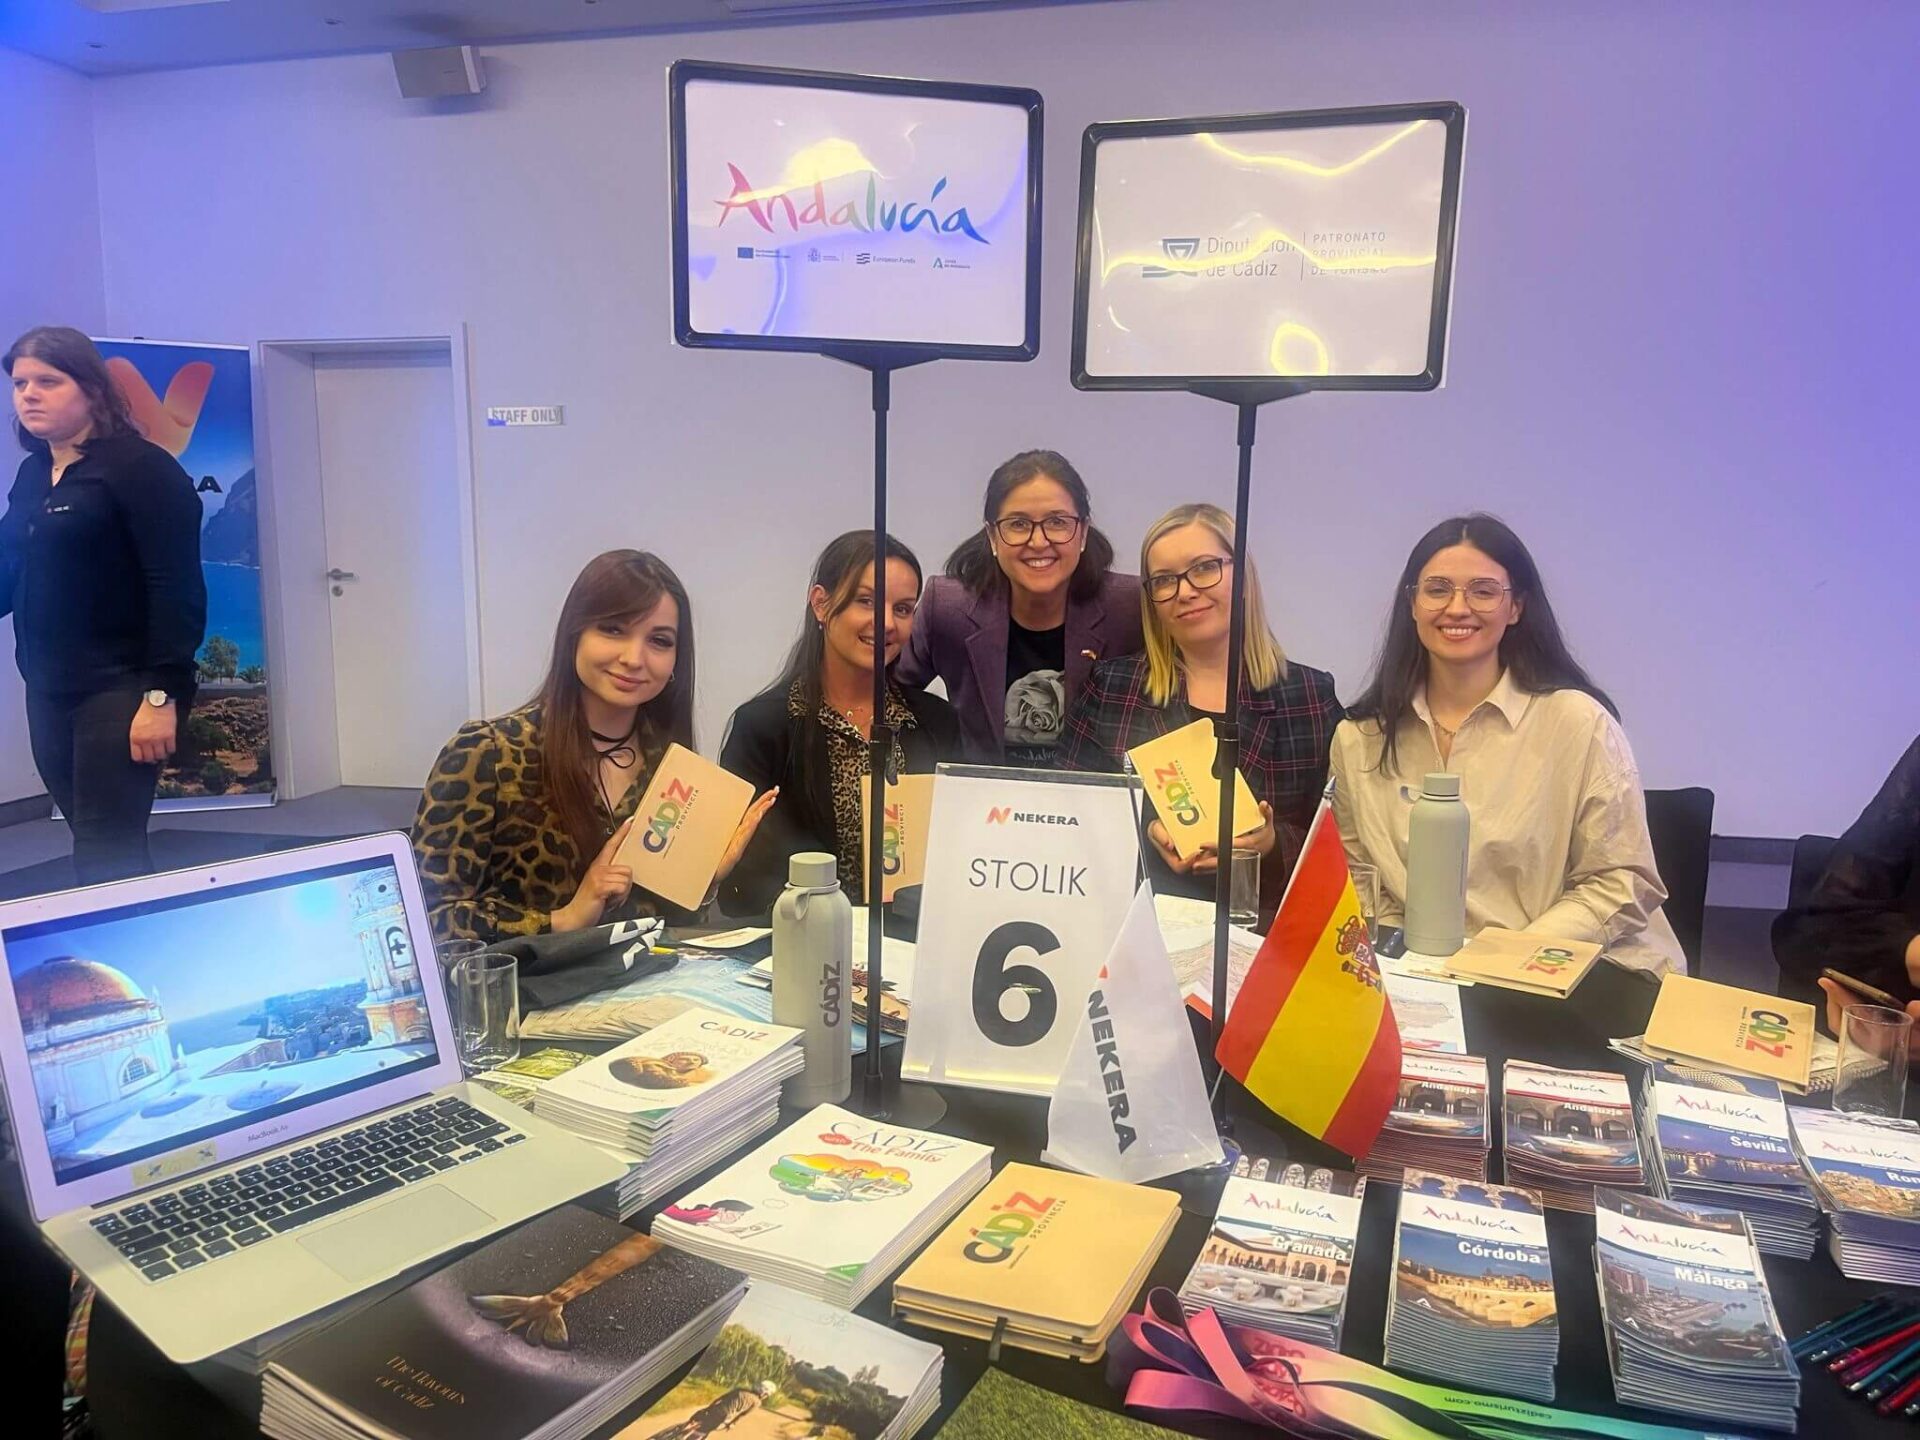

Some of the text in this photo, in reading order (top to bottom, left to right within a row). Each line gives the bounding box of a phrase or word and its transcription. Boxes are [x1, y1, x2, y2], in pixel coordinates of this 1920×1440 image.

[713, 162, 991, 245] Andalucía
[1313, 231, 1386, 243] PATRONATO
[492, 409, 561, 423] STAFF ONLY
[1013, 812, 1080, 826] NEKERA
[968, 858, 1087, 897] STOLIK
[972, 920, 1061, 1047] 6
[1088, 989, 1137, 1155] NEKERA
[1675, 1094, 1768, 1123] Andalucía
[851, 1142, 943, 1163] The Family
[1730, 1135, 1787, 1154] Sevilla
[1822, 1140, 1917, 1162] Andalucía
[1029, 1200, 1066, 1239] PROVINCIA
[1244, 1192, 1341, 1223] Andalucía
[1422, 1205, 1523, 1234] Andalucía
[1272, 1235, 1347, 1261] Granada
[1458, 1240, 1541, 1264] Córdoba
[1618, 1223, 1727, 1257] Andalucía
[1674, 1266, 1748, 1290] Málaga
[1443, 1395, 1552, 1420] cadizturismo.com
